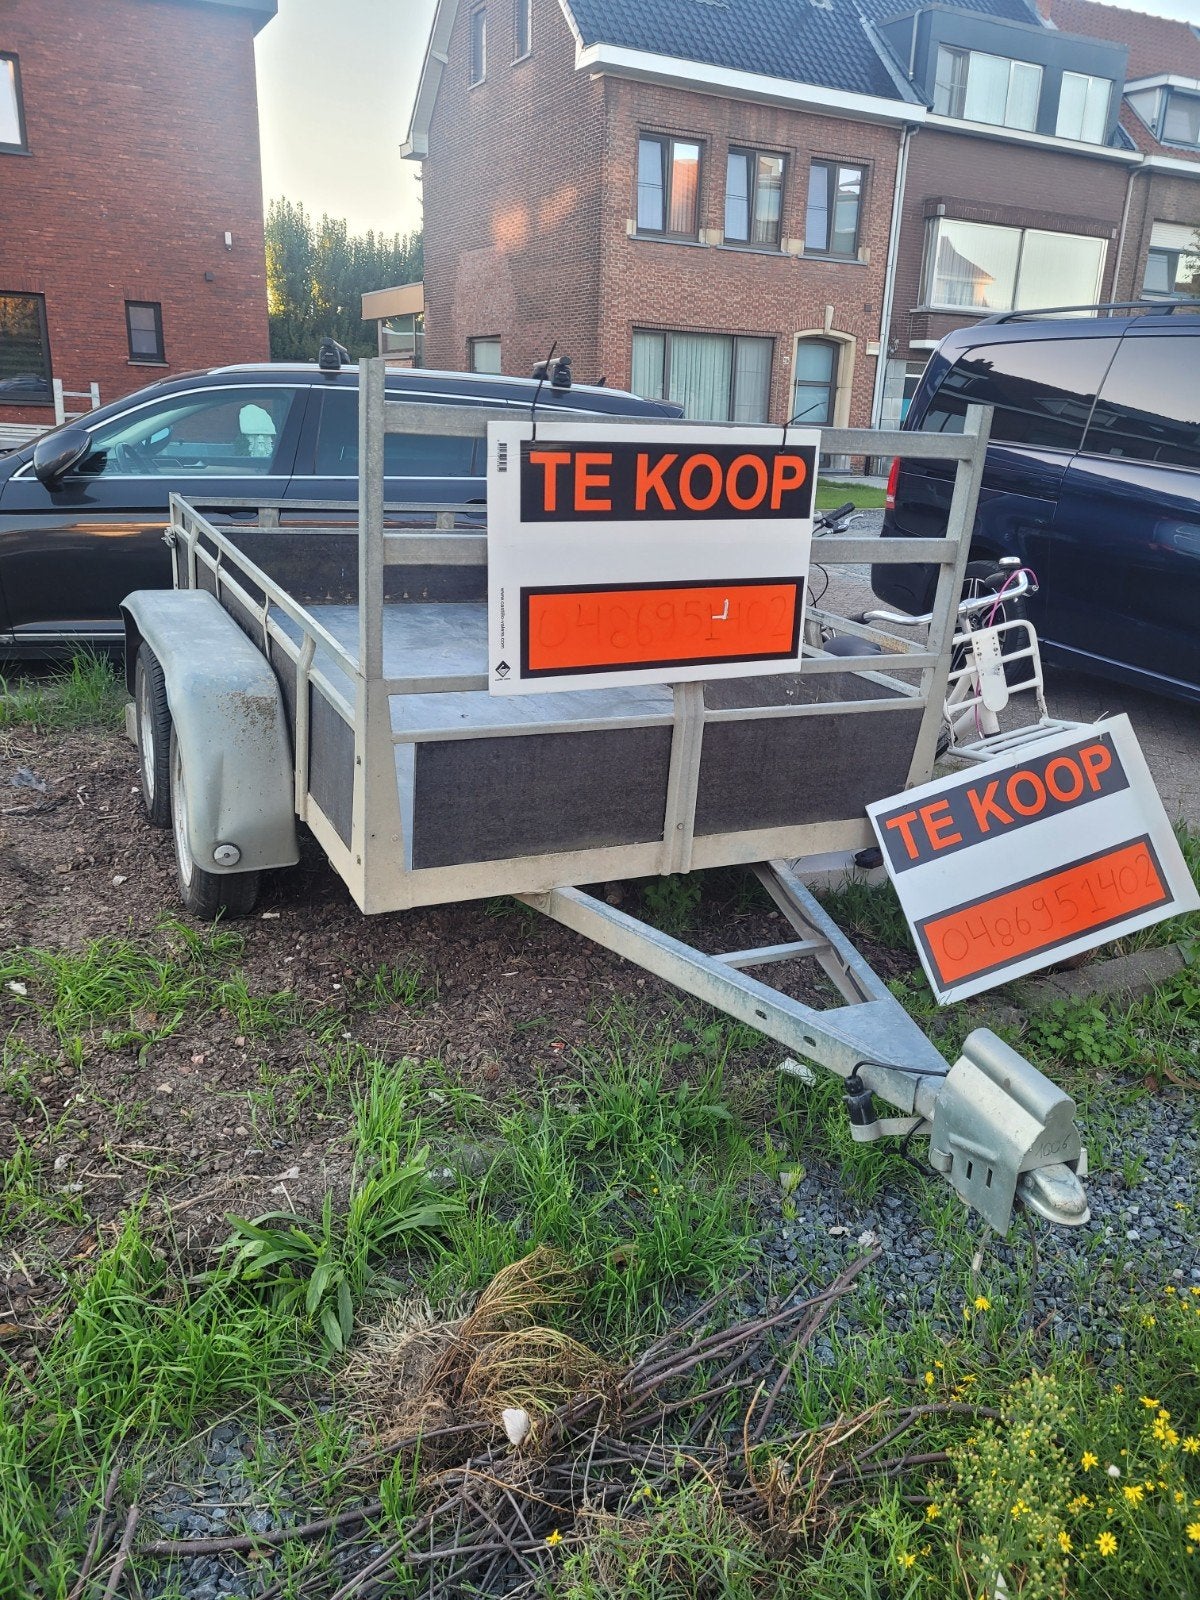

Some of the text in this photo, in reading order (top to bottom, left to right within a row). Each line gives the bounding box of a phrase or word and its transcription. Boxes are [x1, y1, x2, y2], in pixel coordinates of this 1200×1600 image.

[529, 451, 613, 512] TE
[635, 453, 807, 511] KOOP
[885, 744, 1112, 860] TE KOOP
[942, 853, 1157, 962] 0486951402
